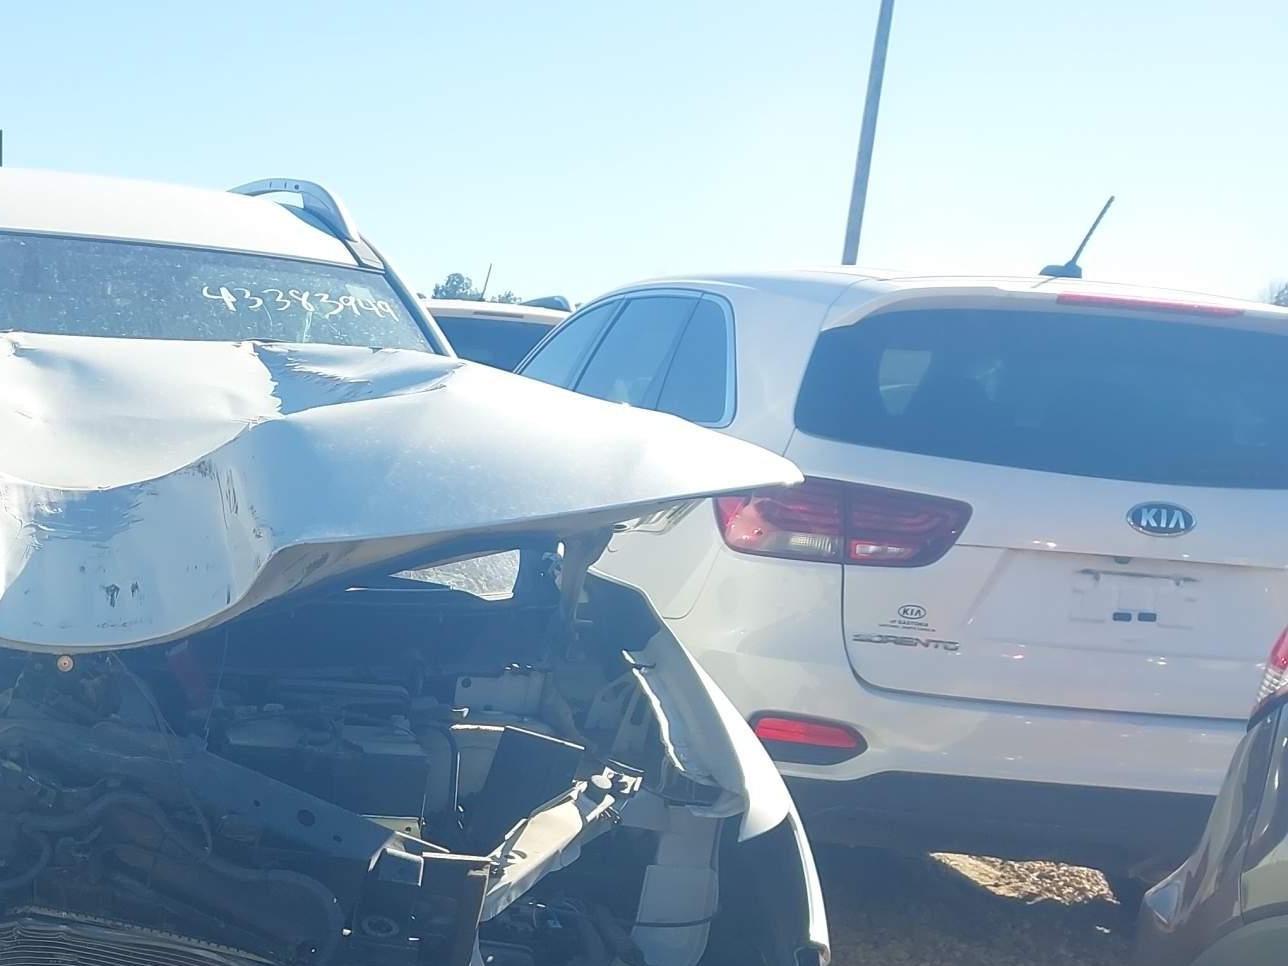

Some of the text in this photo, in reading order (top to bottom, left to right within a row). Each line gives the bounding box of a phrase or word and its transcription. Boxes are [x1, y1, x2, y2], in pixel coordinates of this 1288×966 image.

[202, 283, 400, 322] 43383949
[1140, 507, 1185, 529] KIA
[902, 607, 922, 617] KIA
[851, 634, 960, 652] SORENTO
